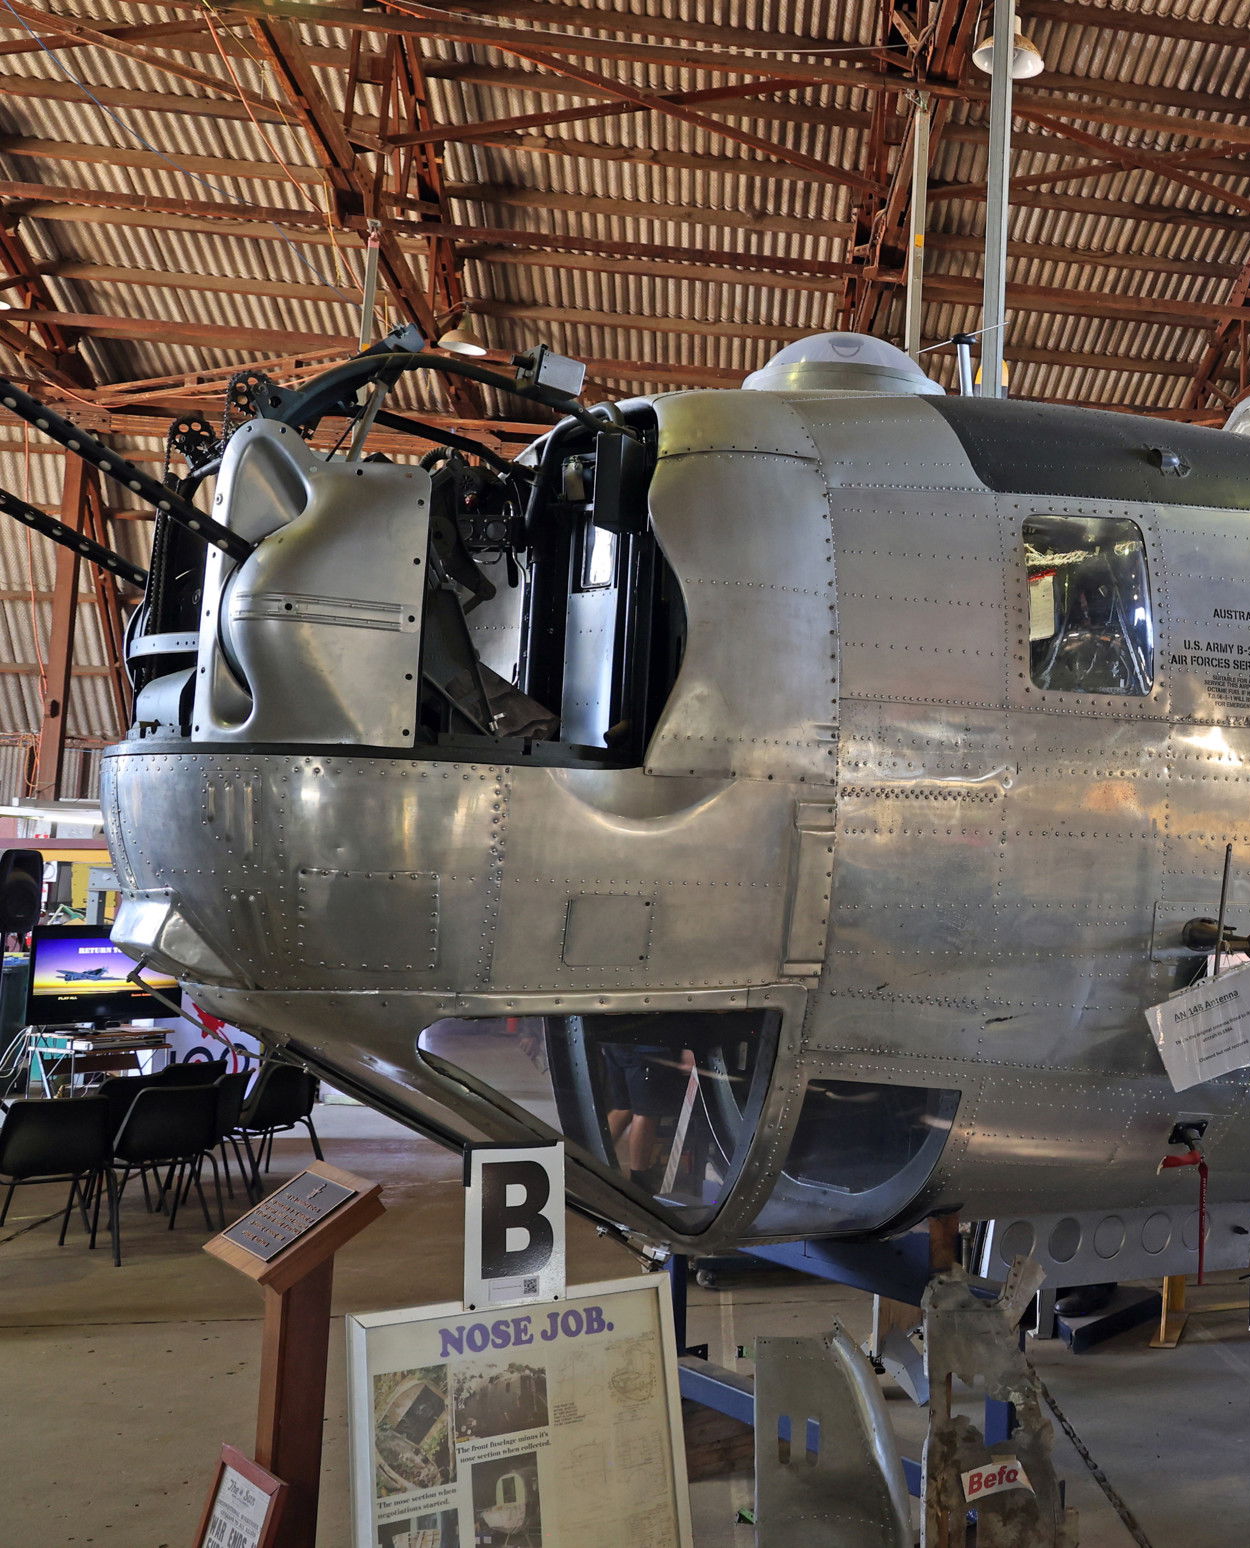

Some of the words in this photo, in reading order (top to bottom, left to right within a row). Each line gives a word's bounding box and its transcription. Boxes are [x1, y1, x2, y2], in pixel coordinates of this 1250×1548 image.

[1183, 640, 1203, 651] U.S.
[1206, 641, 1234, 654] ARMY
[1170, 654, 1188, 666] AIR
[1190, 656, 1230, 670] FORCES
[78, 946, 112, 954] RETURN
[1174, 1012, 1187, 1022] AN
[1205, 989, 1240, 1009] Antenna
[481, 1160, 554, 1280] B
[438, 1316, 535, 1359] NOSE
[540, 1305, 616, 1342] JOB.
[456, 1447, 470, 1455] The
[471, 1443, 489, 1452] front
[490, 1438, 517, 1448] fuselage
[518, 1434, 538, 1442] minus
[539, 1431, 549, 1439] it's
[460, 1456, 476, 1464] nose
[476, 1450, 501, 1460] section
[502, 1446, 520, 1455] when
[520, 1439, 552, 1451] collected.
[376, 1501, 392, 1509] The
[393, 1498, 411, 1506] nose
[411, 1492, 437, 1502] section
[438, 1487, 457, 1496] when
[209, 1514, 227, 1543] WAR
